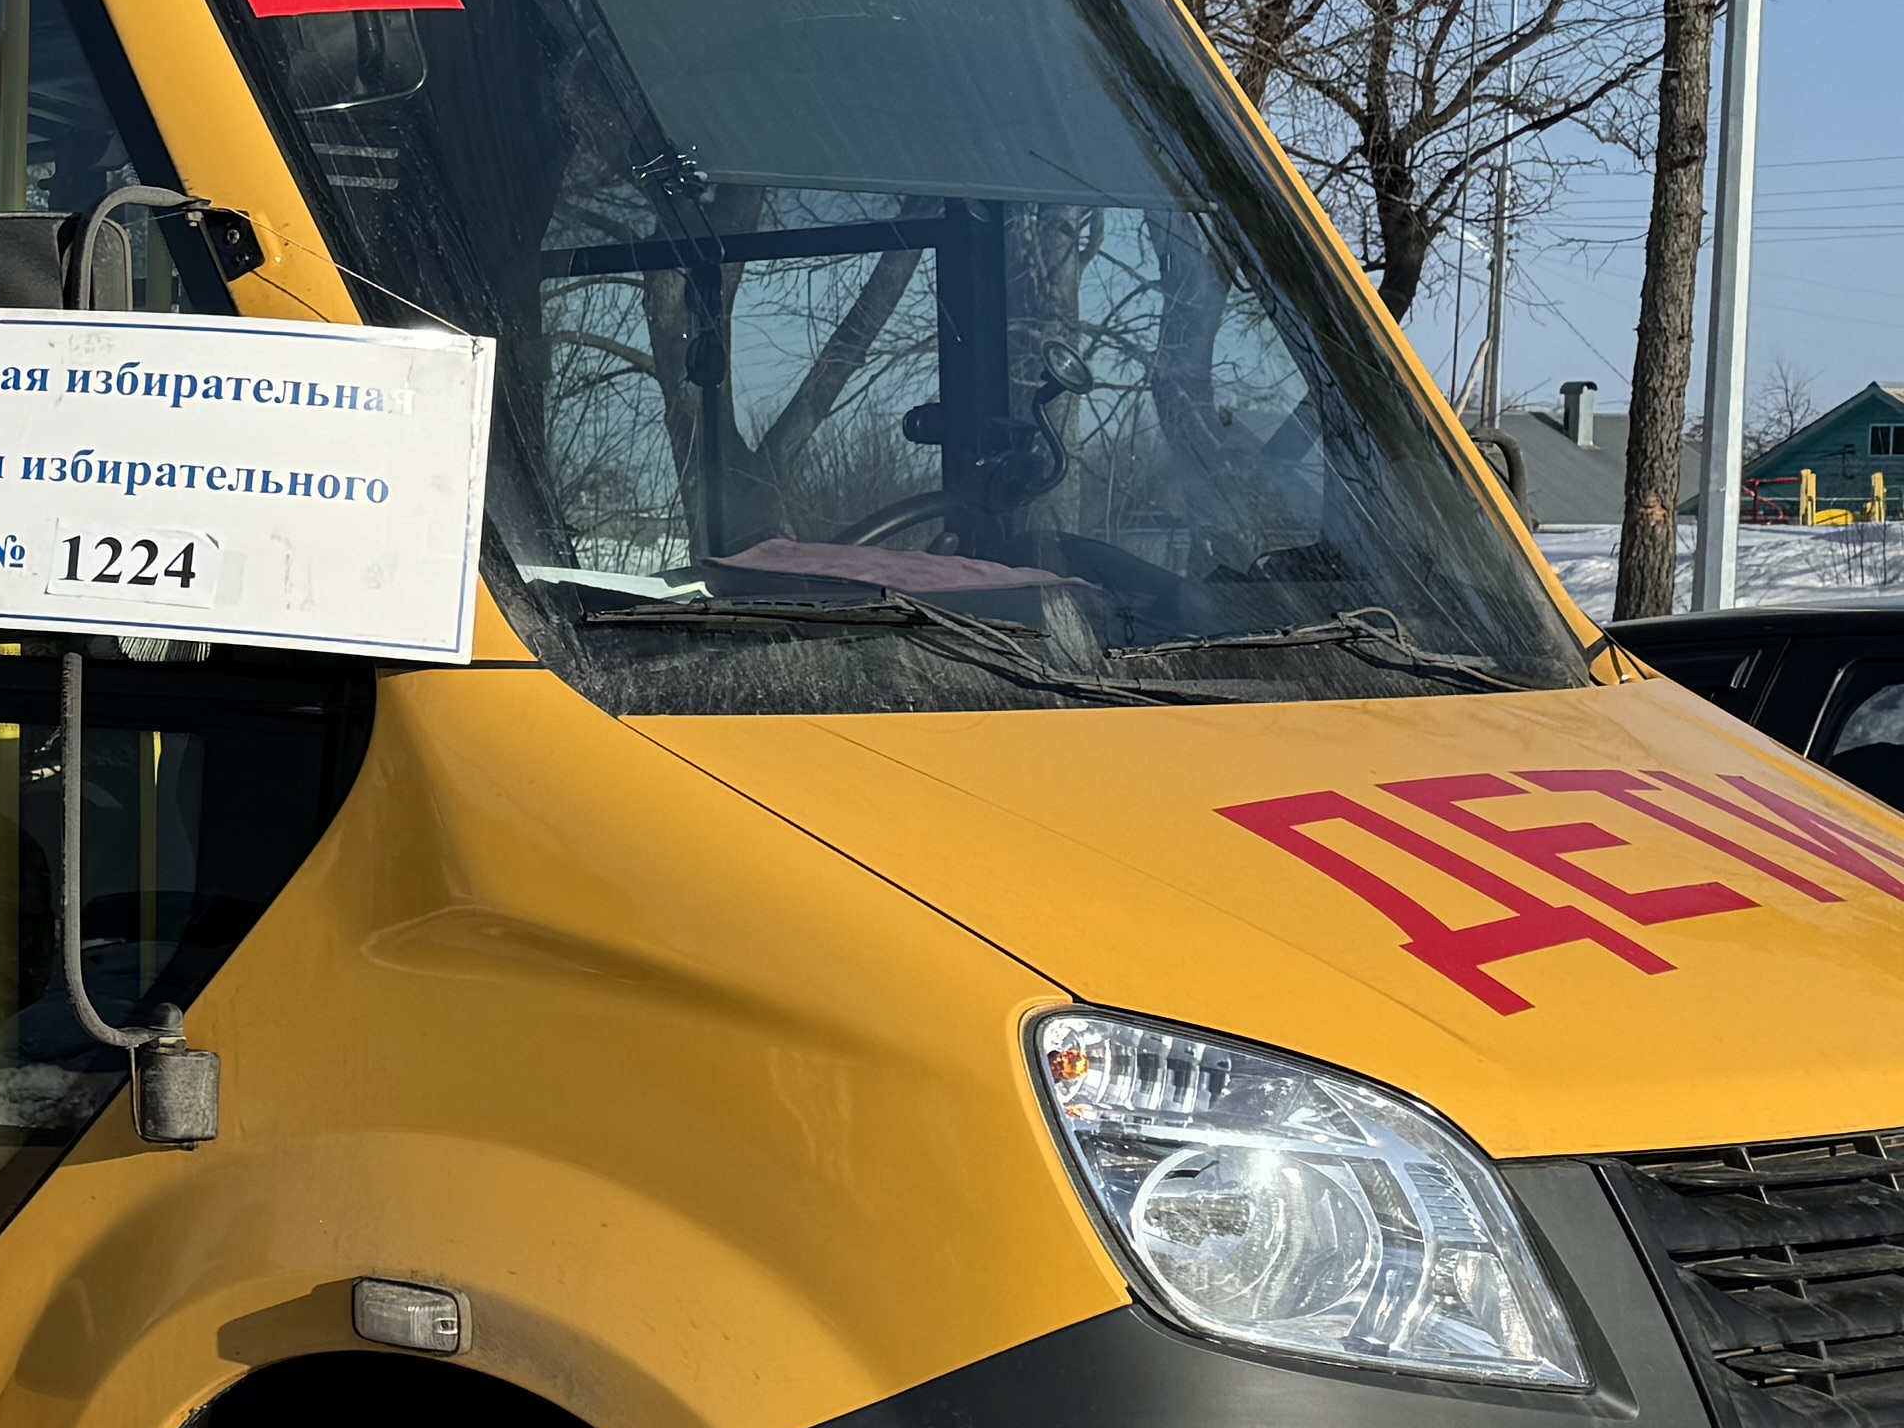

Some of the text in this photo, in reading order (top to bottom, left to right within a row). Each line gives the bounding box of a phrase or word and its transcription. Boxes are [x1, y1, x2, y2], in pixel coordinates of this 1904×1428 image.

[20, 448, 390, 504] избирательного
[59, 534, 196, 589] 1224
[1212, 769, 1904, 1017] ДЕТИ
